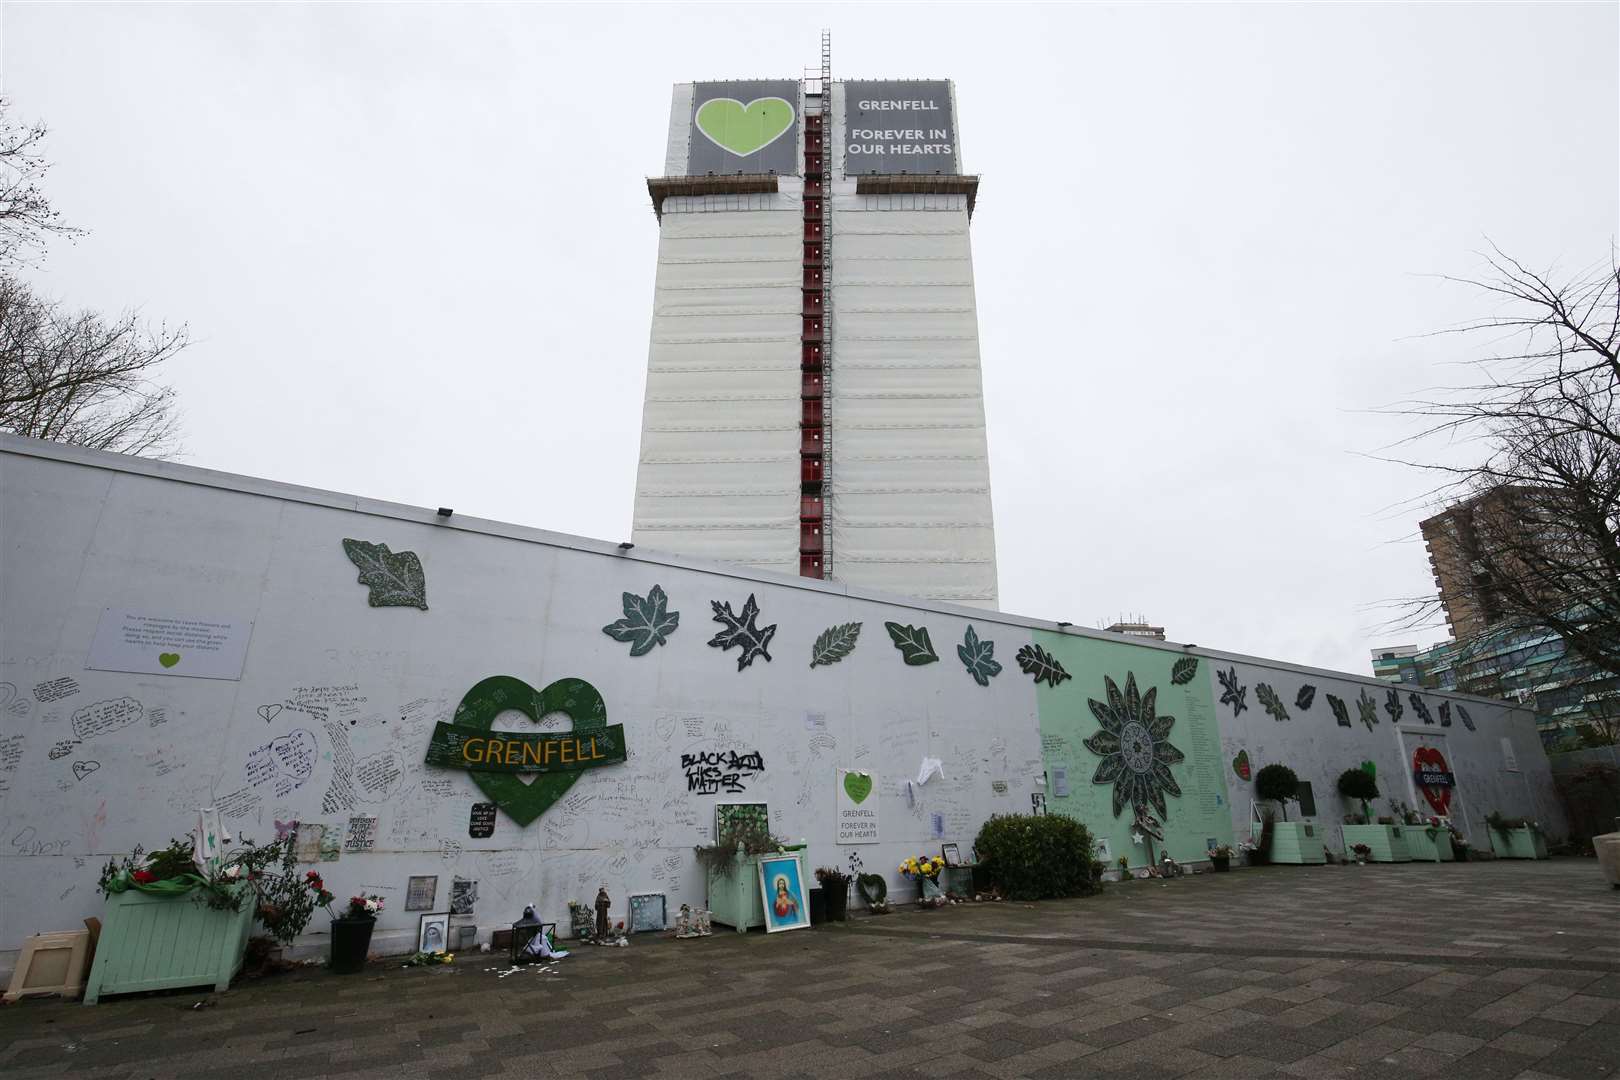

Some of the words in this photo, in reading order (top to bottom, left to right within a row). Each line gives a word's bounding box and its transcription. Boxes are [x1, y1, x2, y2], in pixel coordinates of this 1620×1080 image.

[858, 100, 939, 110] GRENFELL
[852, 129, 925, 139] FOREVER
[929, 129, 947, 139] IN
[848, 144, 885, 154] OUR
[890, 144, 952, 154] HEARTS
[463, 737, 606, 764] GRENFELL
[681, 752, 728, 769] BLACK
[687, 773, 746, 792] MATTER
[842, 810, 875, 818] GRENFELL
[345, 840, 375, 848] JUSTICE
